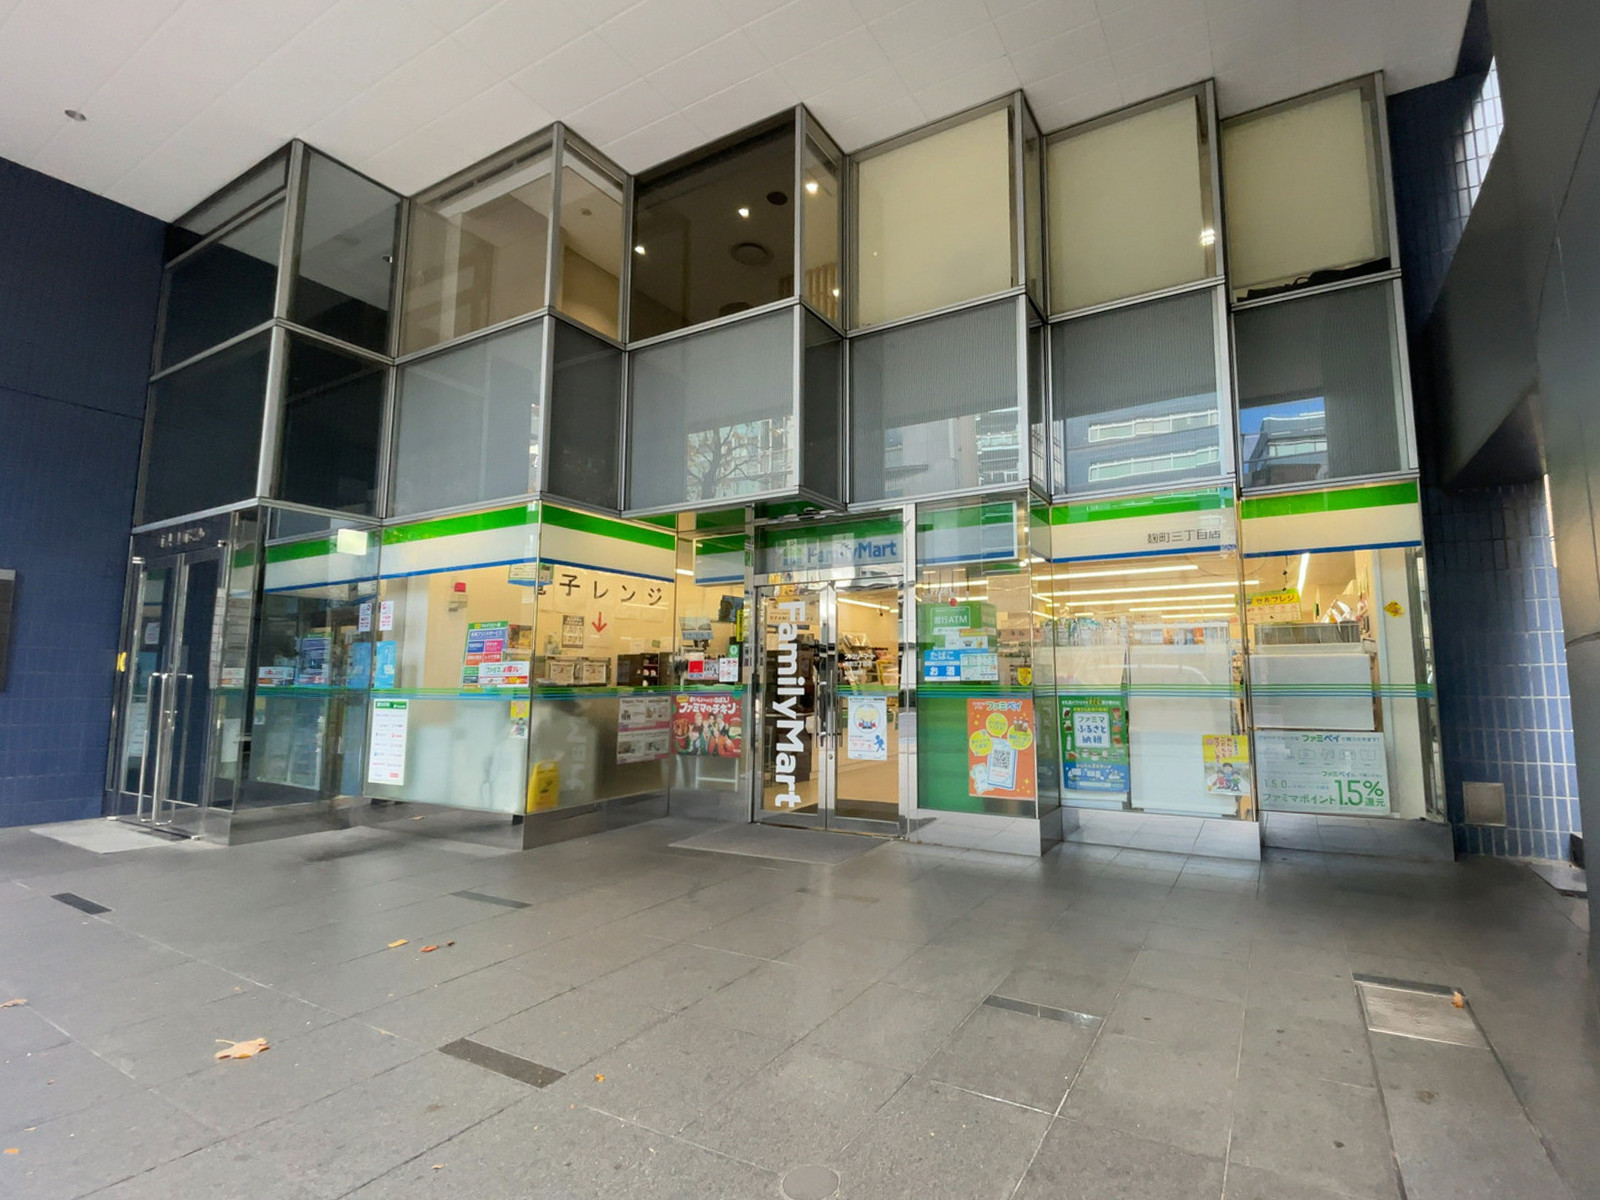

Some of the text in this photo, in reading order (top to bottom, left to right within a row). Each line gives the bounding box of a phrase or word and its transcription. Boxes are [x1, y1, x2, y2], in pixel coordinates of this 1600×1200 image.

[807, 540, 898, 564] FayMart
[537, 573, 662, 606] 子レンジ
[930, 651, 955, 660] たばこ
[679, 702, 736, 714] ファミマのチキン
[772, 600, 805, 808] FamilyMart
[986, 701, 1022, 711] ファミペイ
[1077, 725, 1107, 734] ふるさと
[1302, 734, 1340, 743] ファミペイ
[1263, 793, 1336, 805] ファミマポイント
[1334, 779, 1384, 806] 1.5%
